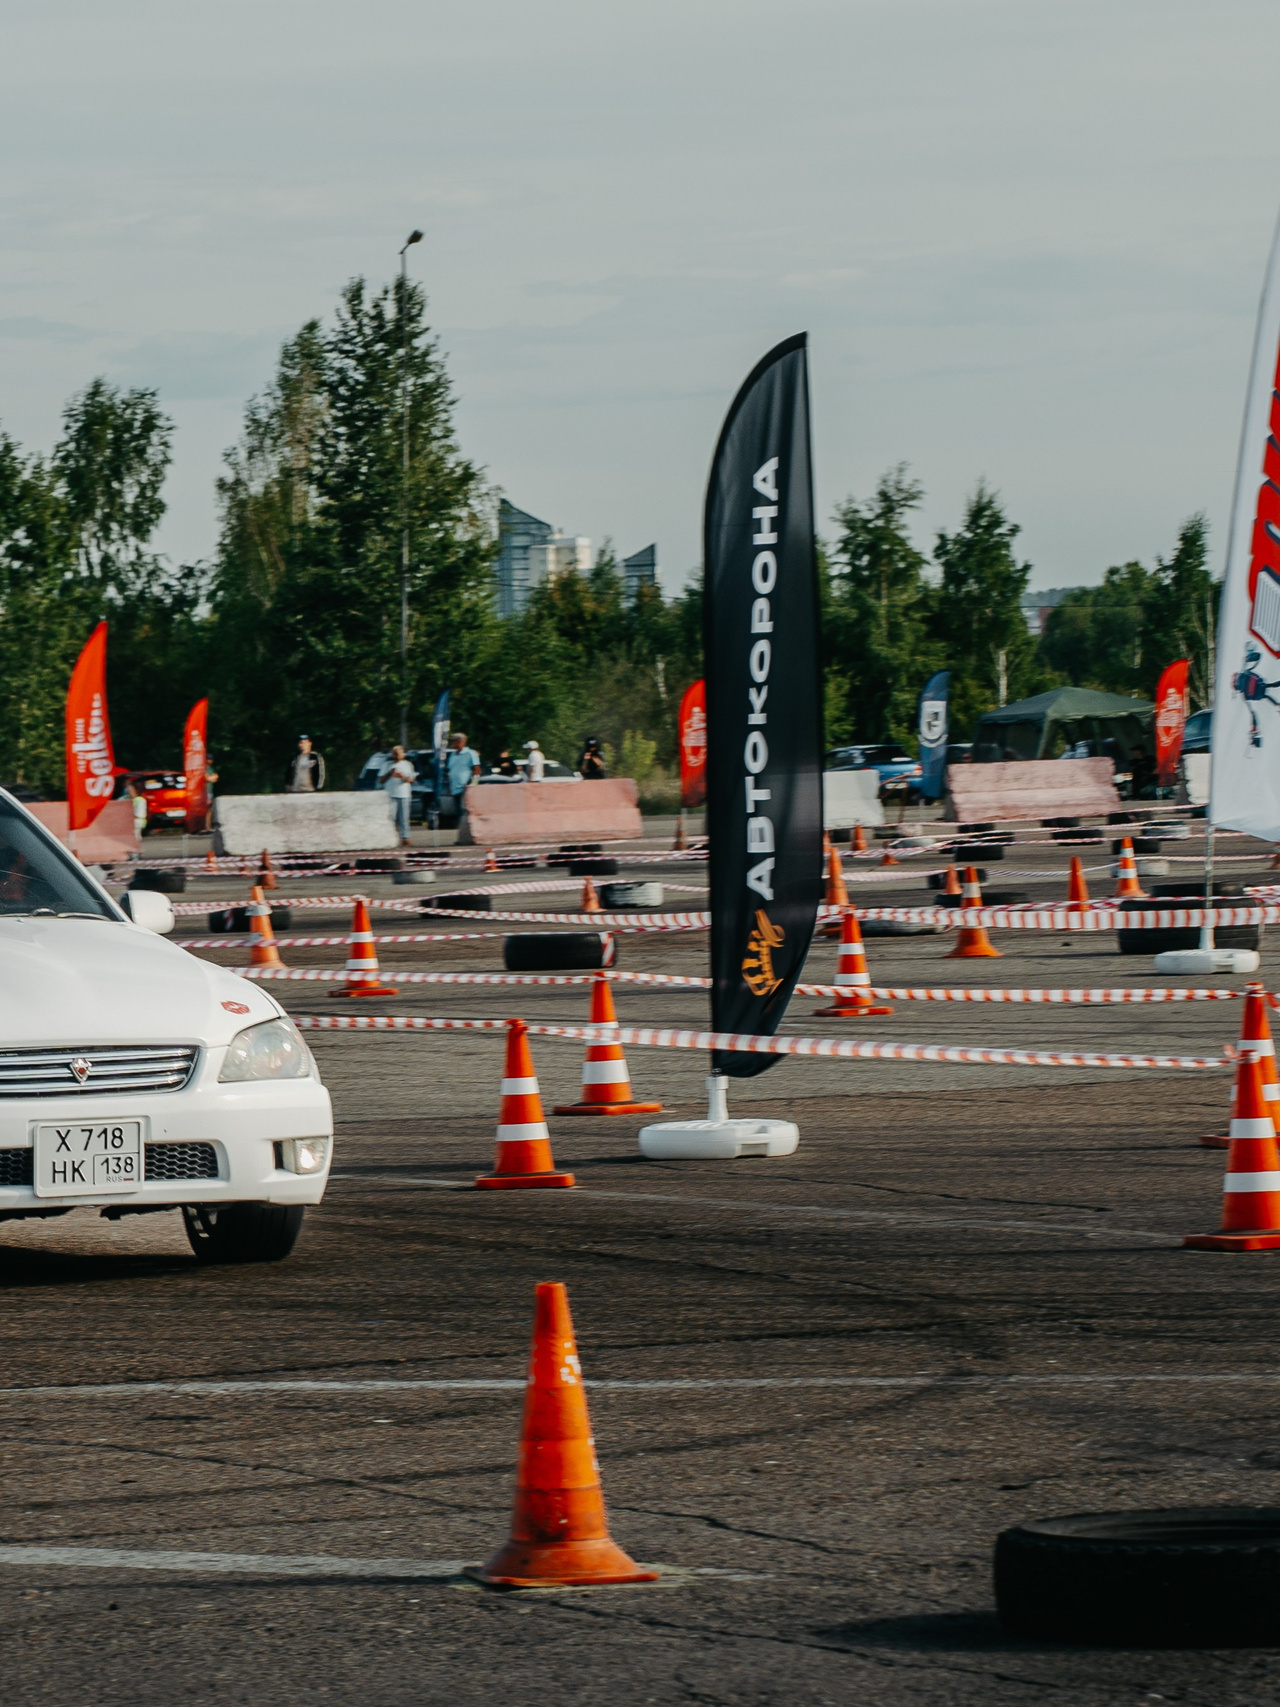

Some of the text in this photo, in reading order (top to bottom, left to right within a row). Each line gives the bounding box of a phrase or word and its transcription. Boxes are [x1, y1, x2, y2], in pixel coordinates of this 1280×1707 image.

[744, 456, 779, 901] АВТОКОРОНА
[55, 1127, 124, 1152] Х 718
[52, 1156, 134, 1183] НК 138
[106, 1175, 123, 1183] RUS
